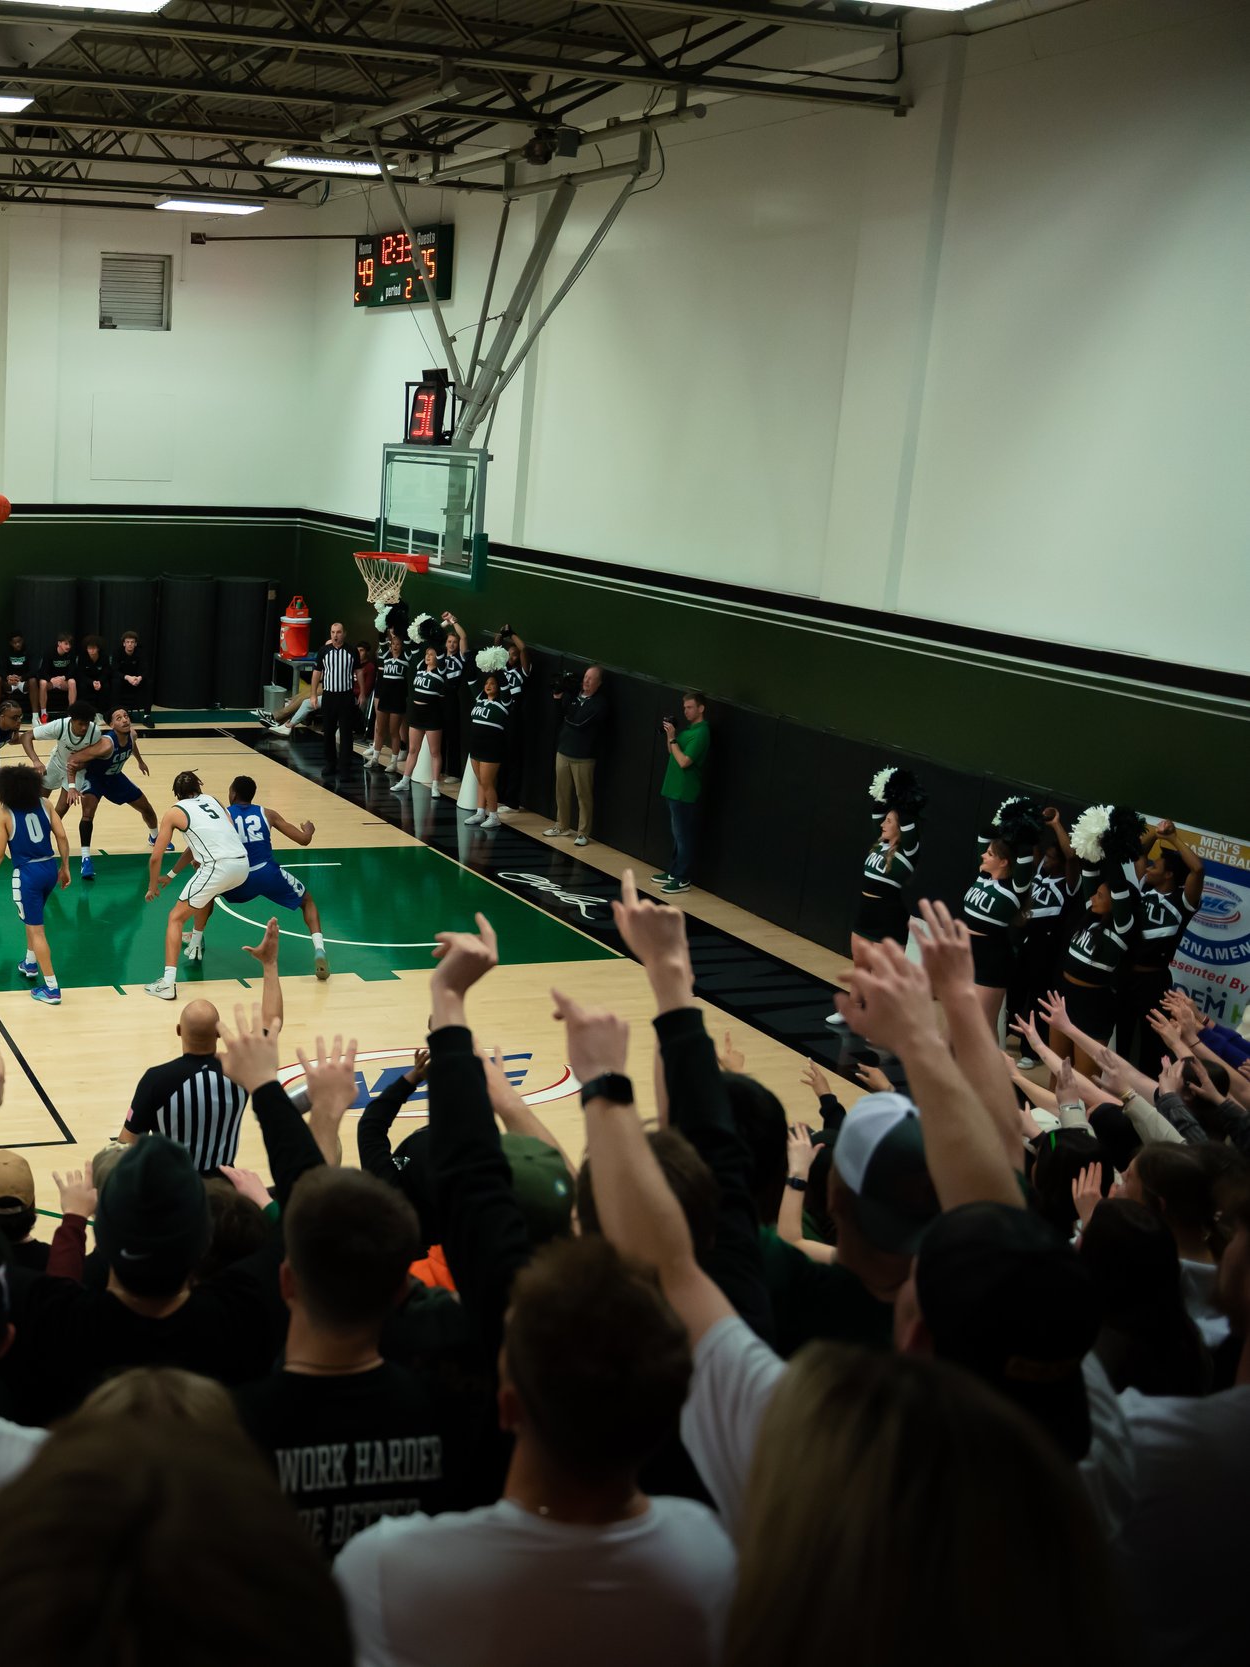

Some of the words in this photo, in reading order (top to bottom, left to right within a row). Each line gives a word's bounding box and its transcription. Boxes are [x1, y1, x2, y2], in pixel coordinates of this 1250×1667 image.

[358, 258, 374, 286] 49
[385, 284, 402, 300] period
[405, 277, 413, 299] 2
[198, 803, 220, 820] 5
[25, 813, 43, 843] 0
[233, 815, 263, 842] 12
[1184, 843, 1250, 871] ASKETBAL
[1200, 835, 1241, 856] MEN'S
[1229, 977, 1249, 994] By
[275, 1443, 349, 1494] WORK
[353, 1435, 443, 1486] HARDER
